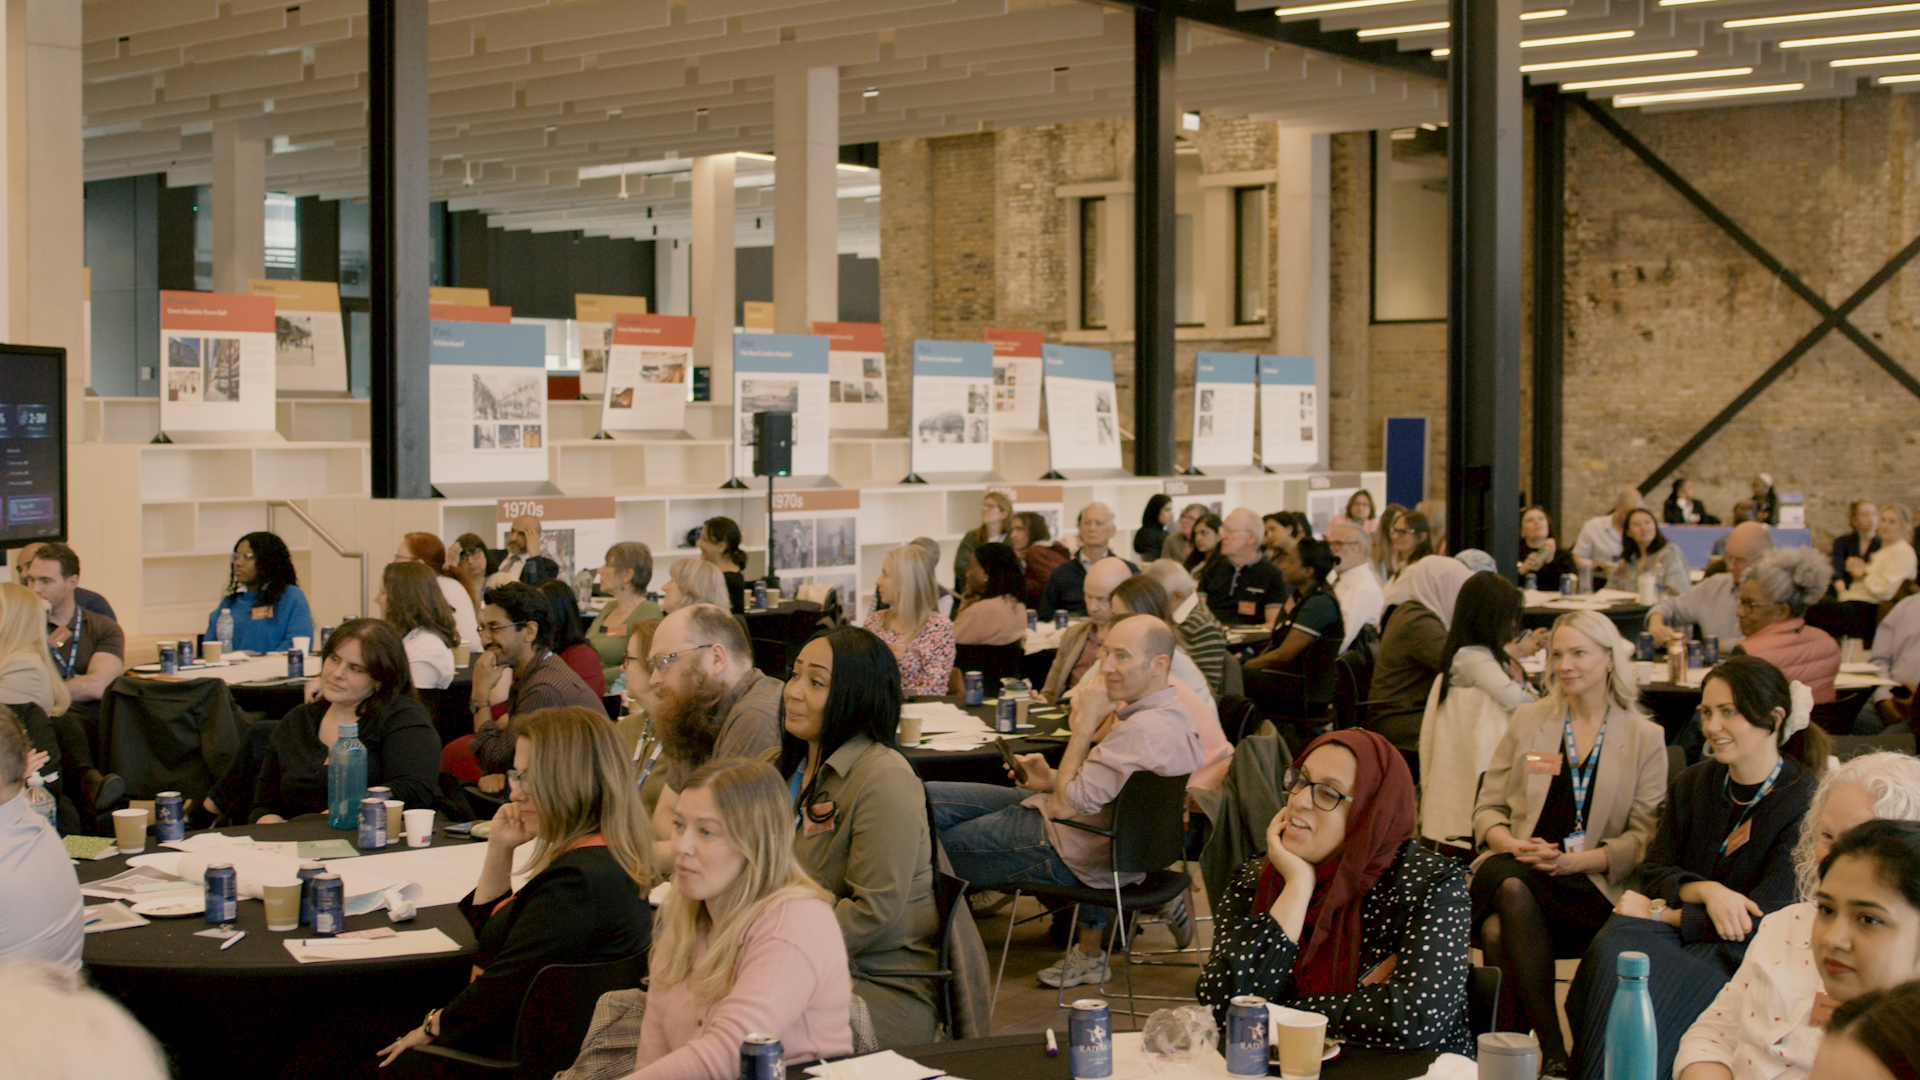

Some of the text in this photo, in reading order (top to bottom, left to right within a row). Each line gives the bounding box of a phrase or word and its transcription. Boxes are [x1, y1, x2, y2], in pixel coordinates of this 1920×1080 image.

[433, 326, 452, 337] Past
[772, 493, 804, 509] 1970s
[503, 501, 544, 518] 1970s
